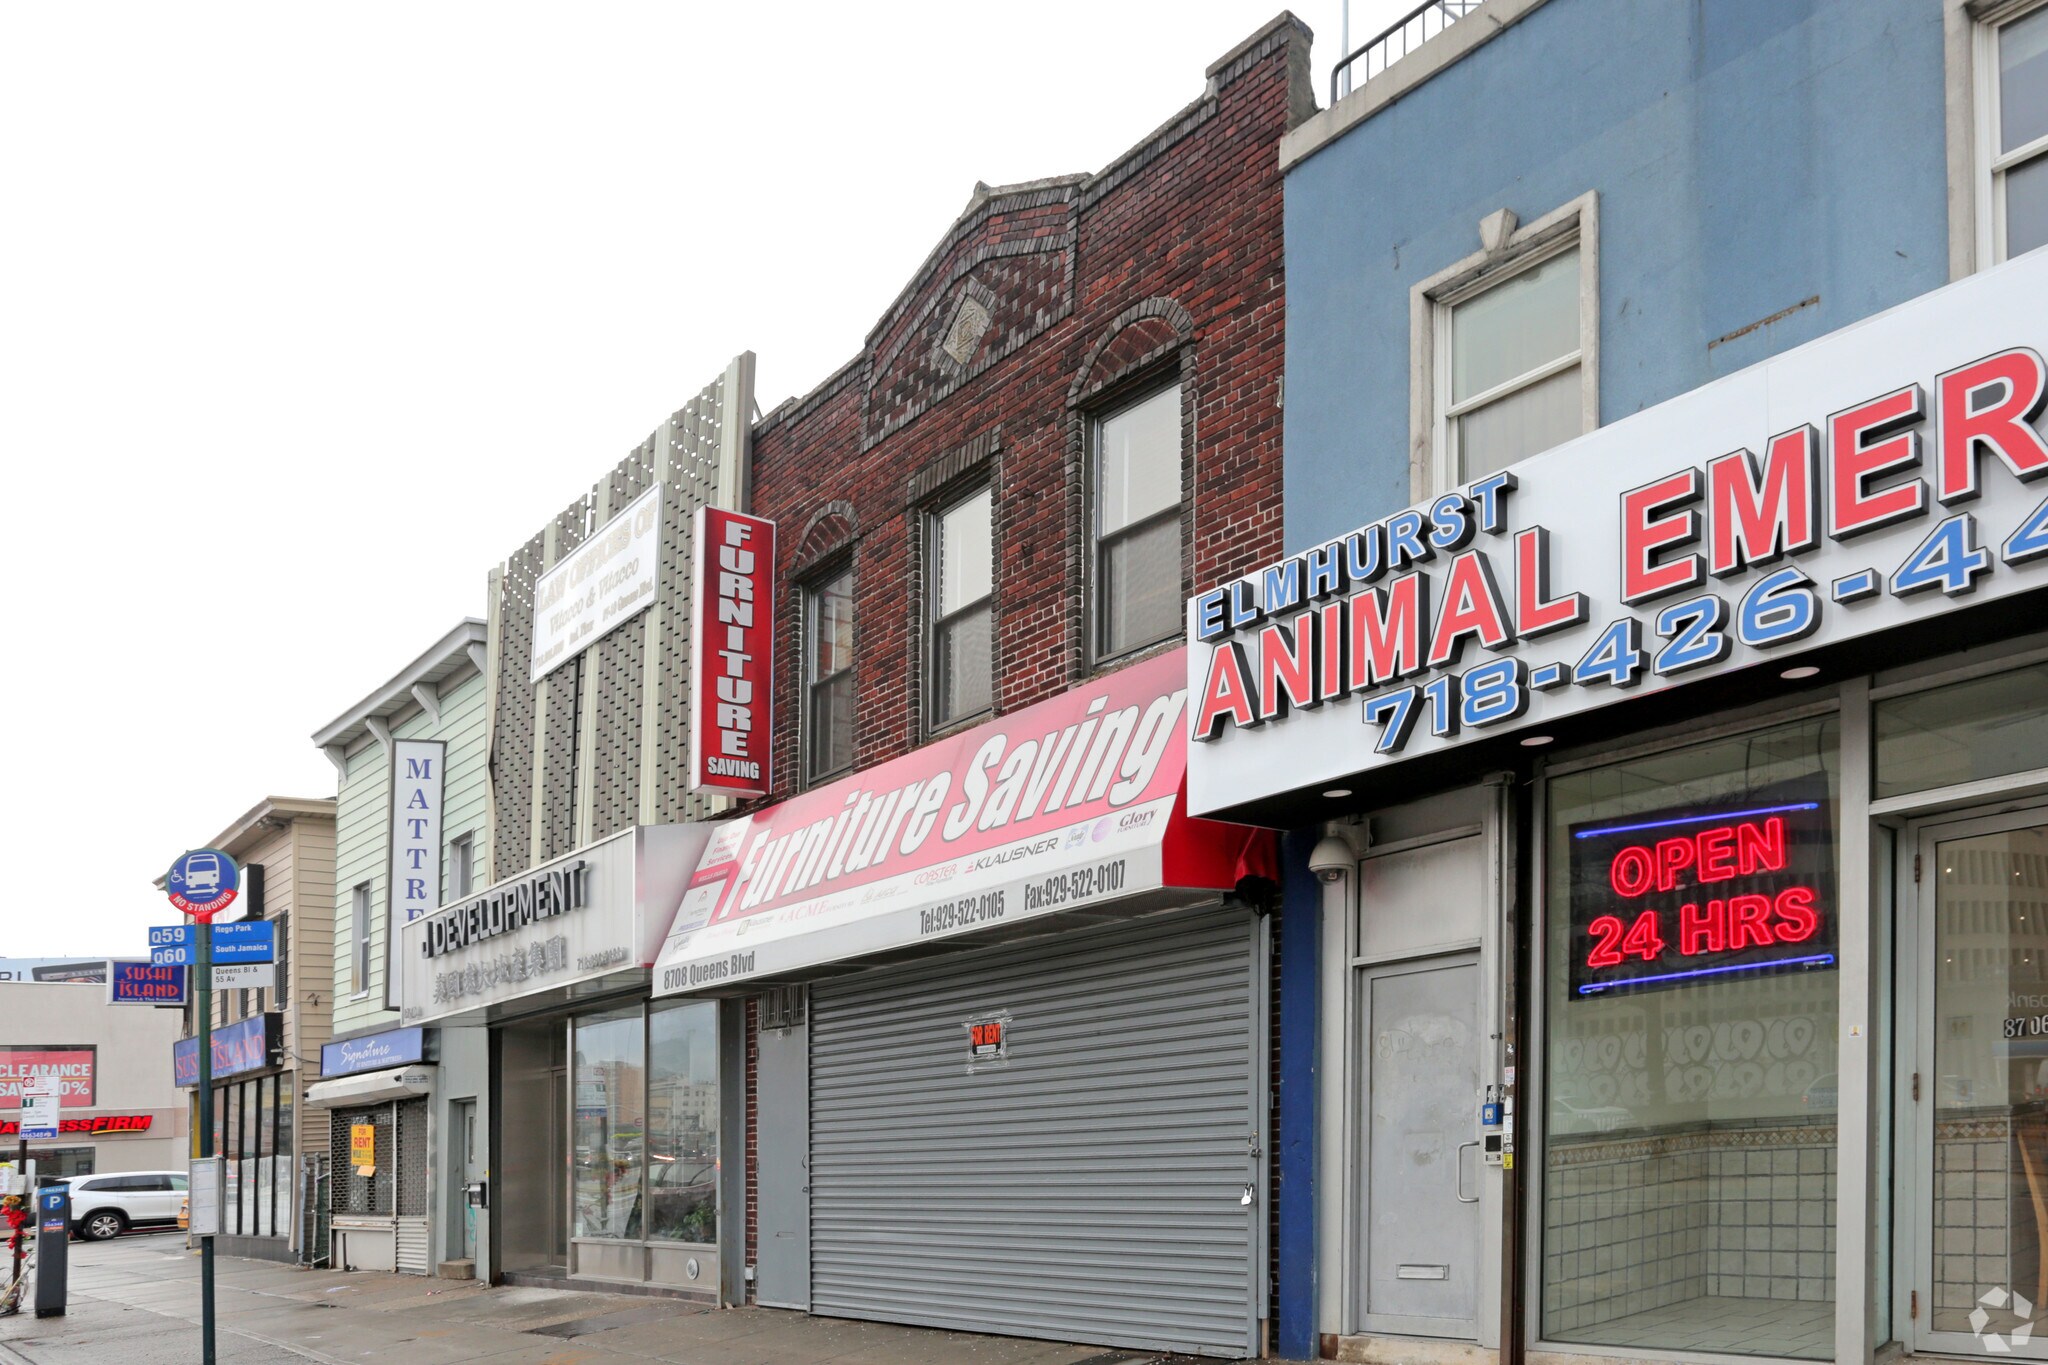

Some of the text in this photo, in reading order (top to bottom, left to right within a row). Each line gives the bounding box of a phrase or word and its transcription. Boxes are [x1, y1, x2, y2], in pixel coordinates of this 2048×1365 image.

[1192, 346, 2048, 742] ANIMAL EMER
[1197, 471, 1519, 642] ELMHURST
[537, 568, 569, 614] LAW
[717, 520, 755, 757] FURNITURE
[707, 756, 760, 781] SAVING
[718, 688, 1187, 921] Furniture Saving
[1120, 809, 1158, 827] Glory
[707, 853, 732, 866] Services
[975, 837, 1059, 871] KLAUSNER
[1610, 817, 1786, 897] OPEN
[173, 891, 232, 912] NO STANDING
[920, 890, 1004, 935] Tel:929-522-0105
[1024, 860, 1126, 911] Fax:929-522-0107
[422, 860, 586, 959] J DEVELOPMENT
[151, 927, 186, 944] Q59
[215, 924, 252, 934] Rego Park
[1587, 887, 1819, 968] 24 HRS
[154, 947, 187, 964] Q60
[215, 943, 268, 953] South Jamaica
[125, 966, 174, 982] SUSHI
[215, 967, 241, 976] Queens
[227, 975, 236, 983] Av
[664, 950, 755, 990] 8708 Queens Blvd
[119, 979, 180, 998] ISLAND
[971, 1023, 1001, 1046] FOR RENT
[2004, 1017, 2026, 1038] 87
[177, 1052, 200, 1079] SUS
[340, 1040, 391, 1070] Signature
[0, 1064, 91, 1077] CLEARANCE
[353, 1137, 371, 1148] RENT
